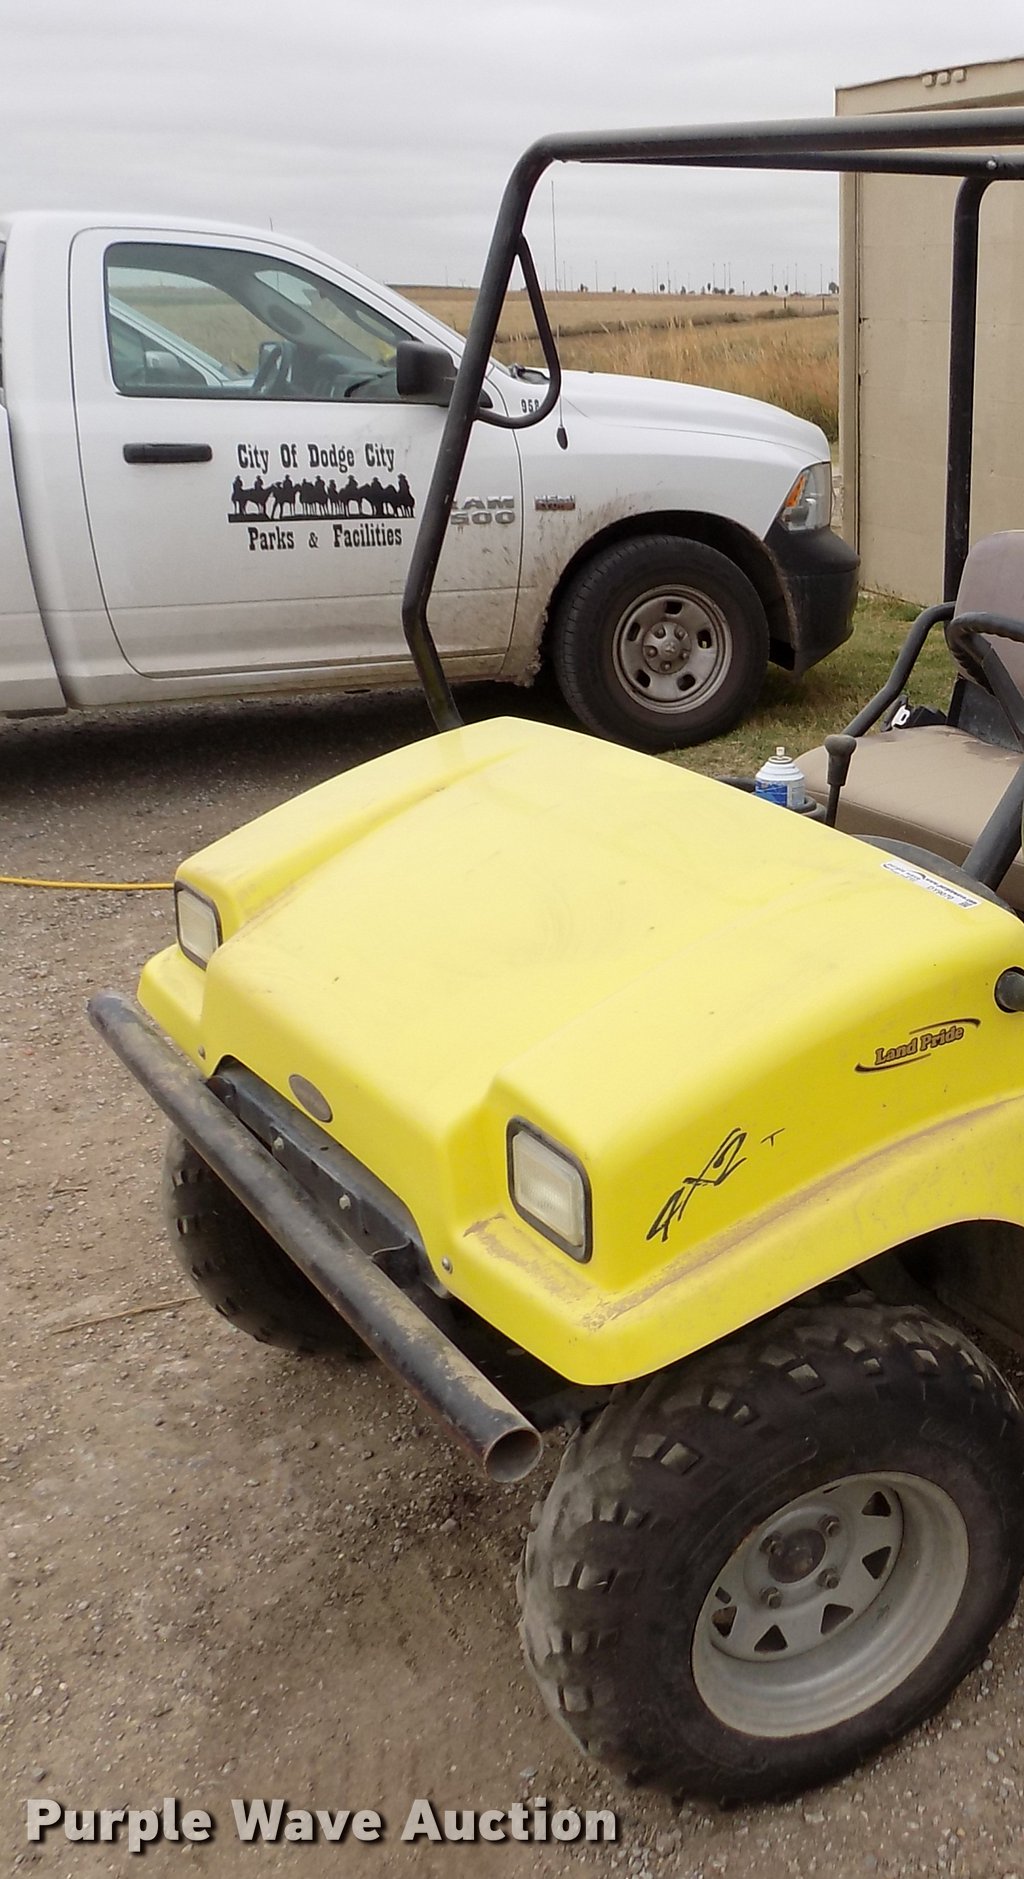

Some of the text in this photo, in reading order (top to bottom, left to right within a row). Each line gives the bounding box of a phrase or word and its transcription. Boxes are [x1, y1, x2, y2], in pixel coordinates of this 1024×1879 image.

[237, 443, 395, 474] City Of Dodge City
[452, 496, 515, 509] AM
[450, 510, 516, 525] 500
[248, 523, 403, 551] Parks & Facilities
[874, 1025, 965, 1065] Land Pride
